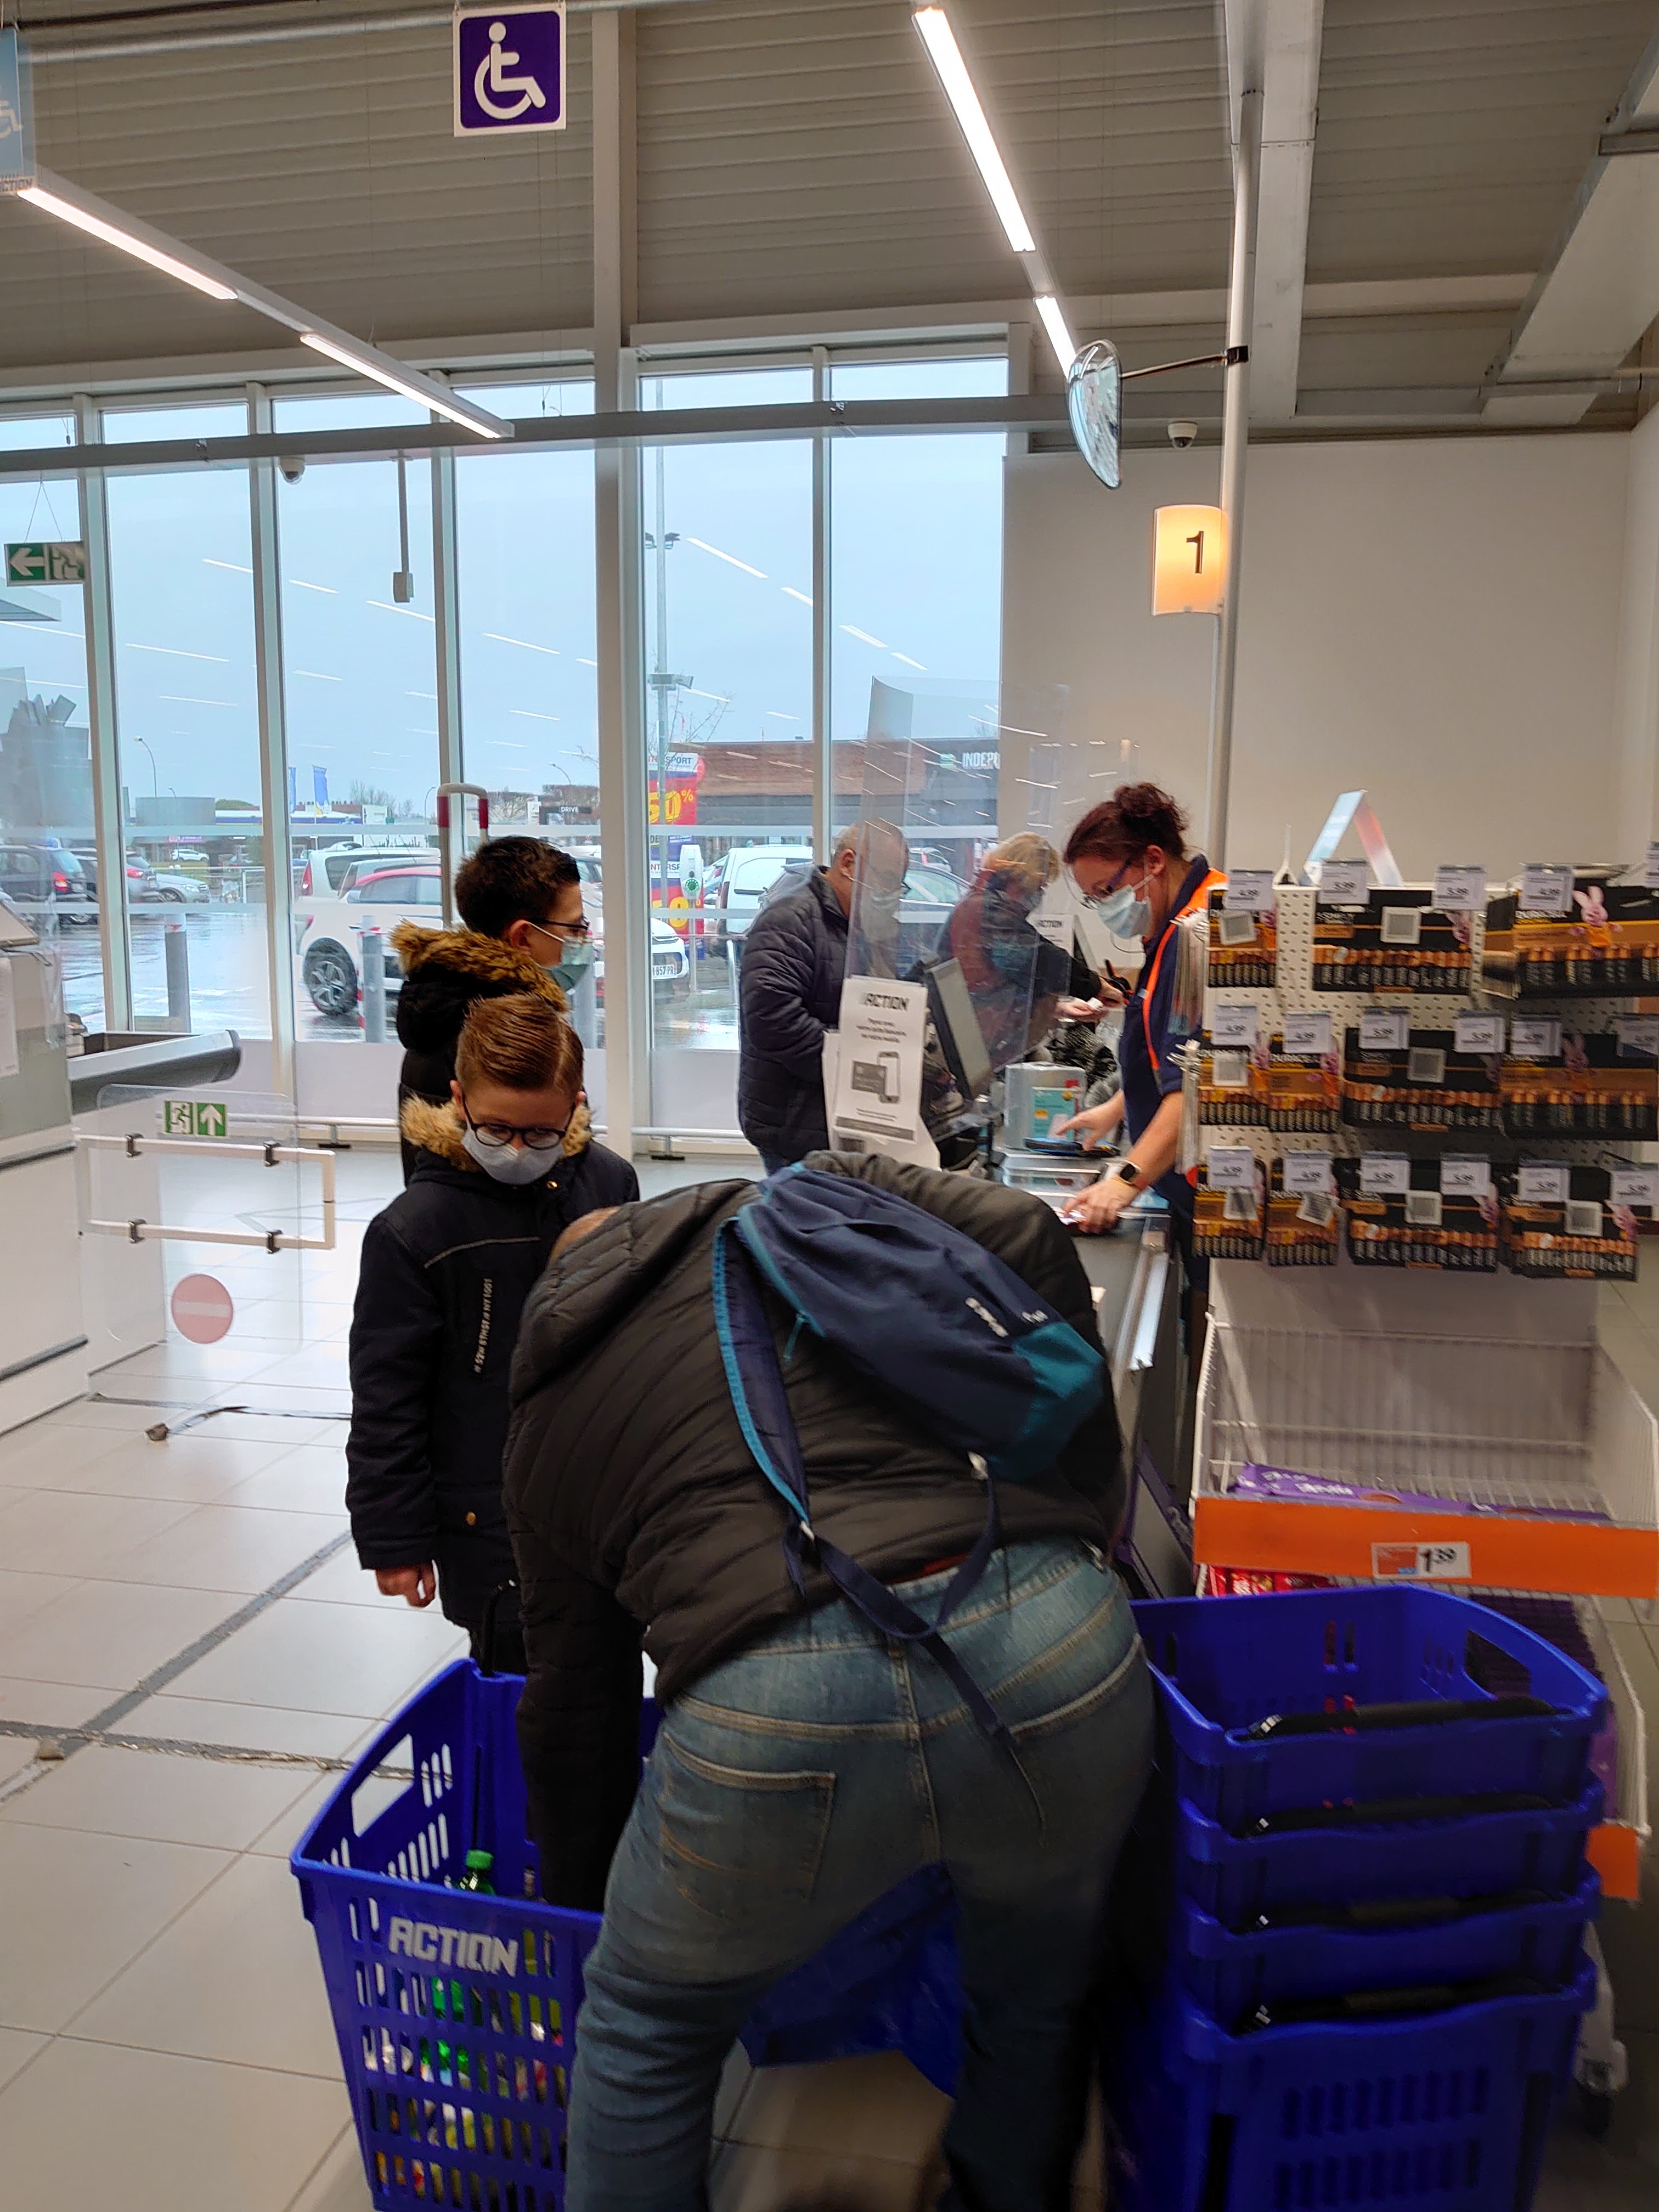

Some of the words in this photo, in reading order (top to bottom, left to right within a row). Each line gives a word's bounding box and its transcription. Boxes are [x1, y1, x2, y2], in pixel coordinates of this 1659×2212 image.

[1186, 531, 1204, 574] 1
[864, 993, 910, 1011] ACTION
[388, 1916, 519, 1978] ACTION
